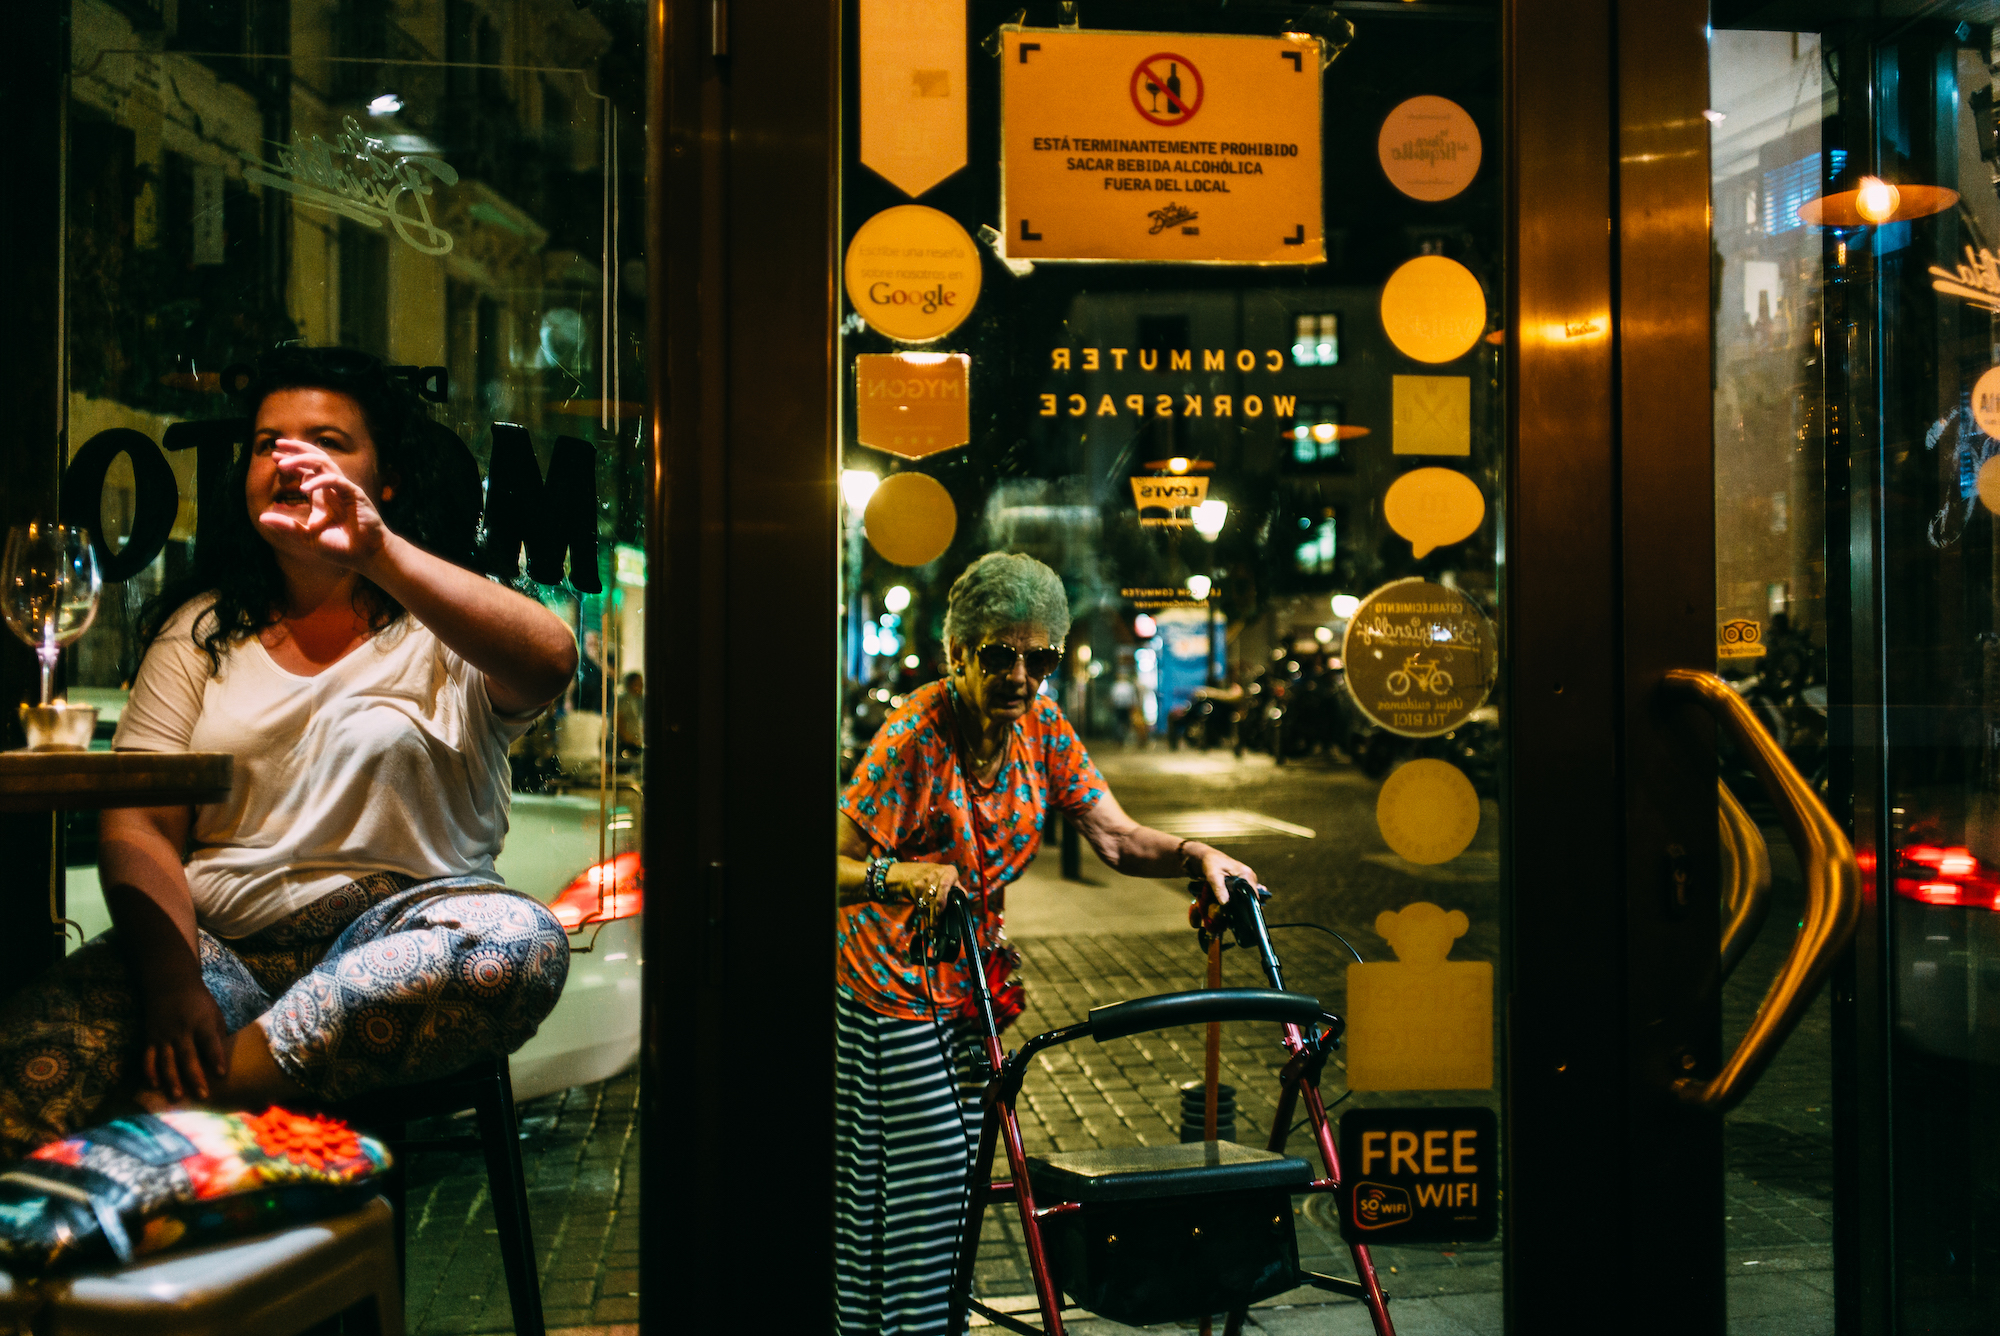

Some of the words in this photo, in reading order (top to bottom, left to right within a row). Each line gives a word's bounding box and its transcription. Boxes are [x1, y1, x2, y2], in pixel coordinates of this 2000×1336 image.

[1033, 135, 1070, 152] ESTÁ
[1072, 138, 1218, 155] TERMINANTEMENTE
[1220, 142, 1299, 157] PROHIBIDO
[1067, 157, 1114, 172] SACAR
[1117, 158, 1171, 173] BEBIDA
[1173, 158, 1263, 175] ALCOHÓLICA
[1104, 177, 1152, 191] FUERA
[1155, 178, 1183, 192] DEL
[1185, 179, 1231, 193] LOCAL
[868, 281, 957, 314] Google
[1362, 1130, 1478, 1175] FREE
[1360, 1199, 1380, 1211] SO
[1381, 1203, 1407, 1214] WIFI
[1415, 1183, 1477, 1208] WIFI
